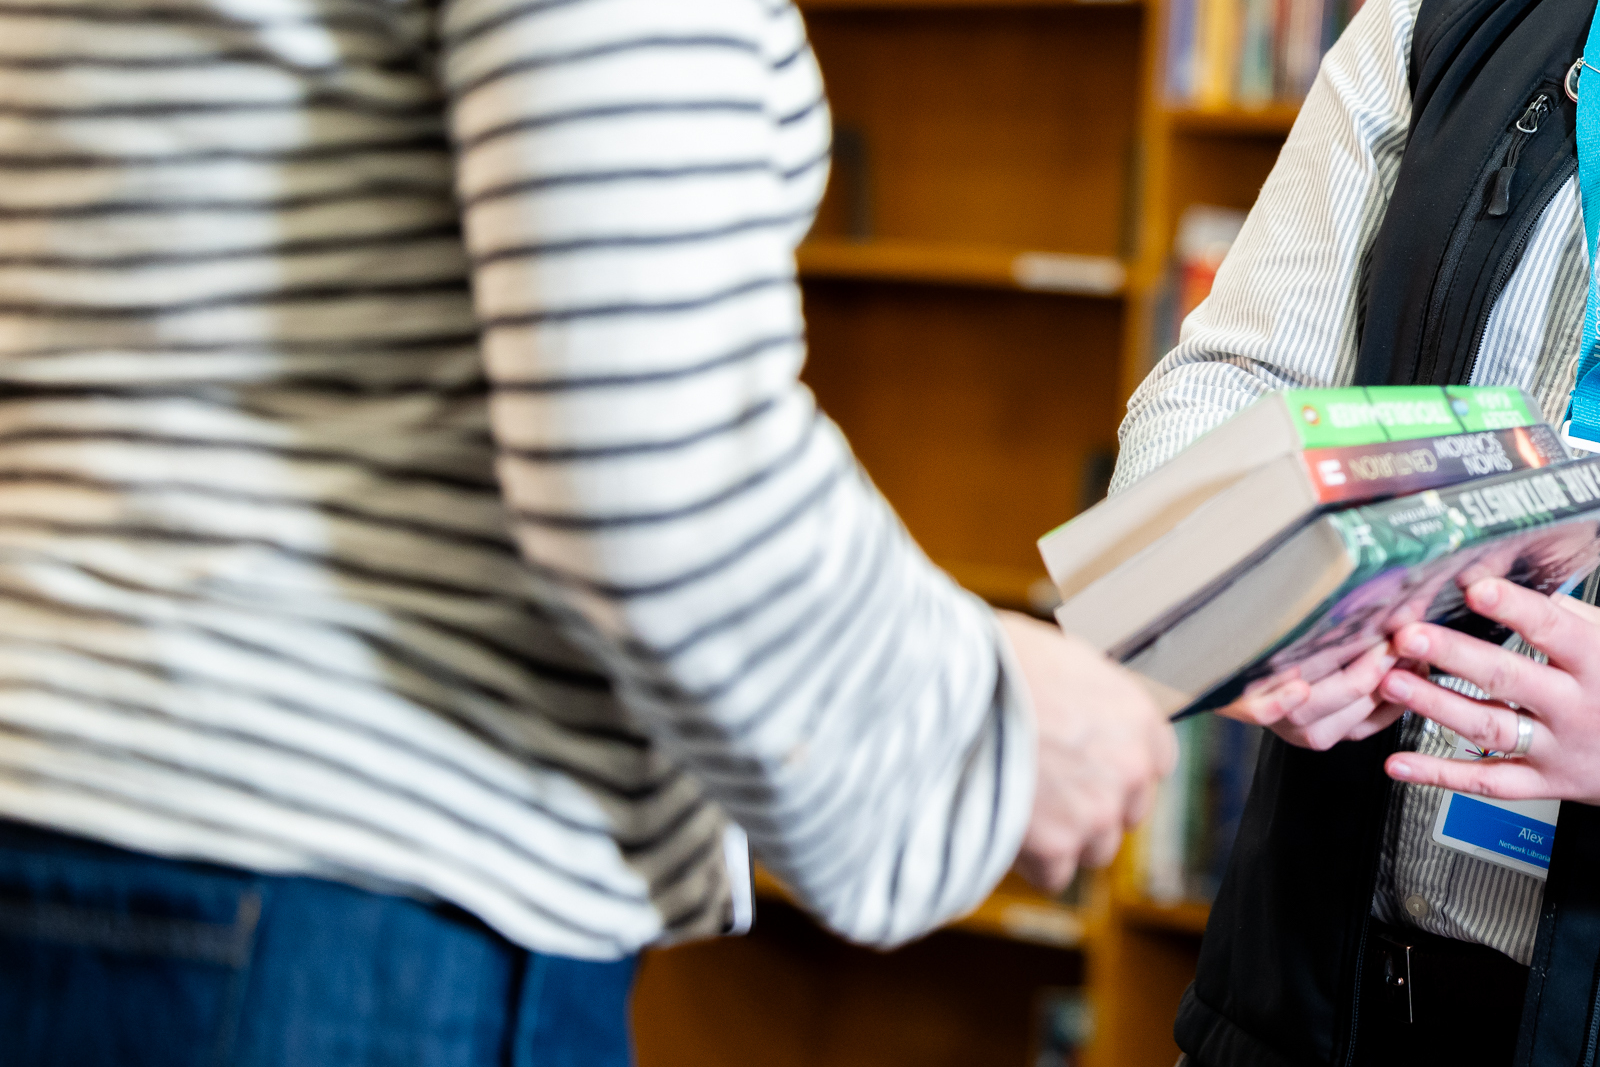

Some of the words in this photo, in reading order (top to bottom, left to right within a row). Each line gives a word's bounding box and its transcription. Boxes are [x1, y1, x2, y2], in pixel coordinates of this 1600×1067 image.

[1433, 431, 1506, 459] SCARROW
[1349, 448, 1438, 480] CENTURION
[1462, 452, 1514, 476] SIMON
[1459, 473, 1570, 528] BOTANISTS
[1518, 827, 1544, 845] Alex
[1499, 839, 1526, 854] Network
[1527, 849, 1551, 863] Libraria
